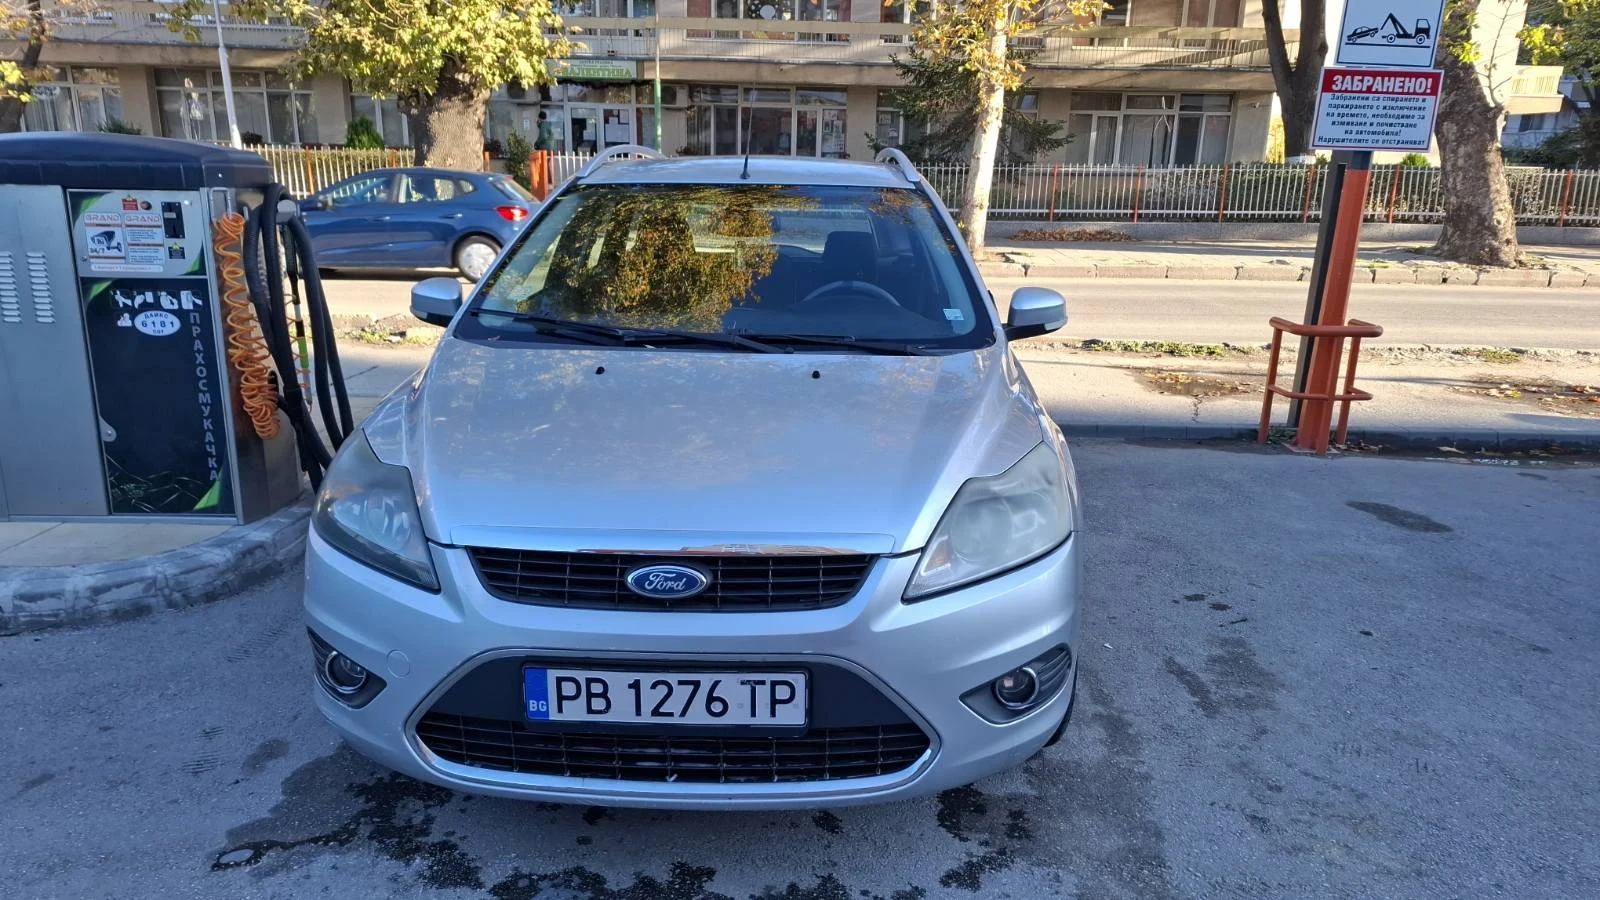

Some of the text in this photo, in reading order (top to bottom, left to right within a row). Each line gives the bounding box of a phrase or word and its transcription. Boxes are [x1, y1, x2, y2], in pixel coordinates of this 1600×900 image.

[1332, 75, 1433, 93] ЗАБРАНЕНО!
[1330, 93, 1370, 102] Забранени
[1328, 103, 1374, 111] паркирането
[1371, 112, 1415, 120] необходимо
[1318, 136, 1370, 145] Нарушителите
[85, 214, 119, 222] GRAND
[125, 215, 160, 223] GRAND
[141, 320, 175, 328] 6181
[189, 312, 220, 481] ПРАХОСМУКАЧКА
[644, 572, 687, 591] Ford
[555, 676, 796, 718] PB 1276 TP
[529, 700, 547, 712] BG
